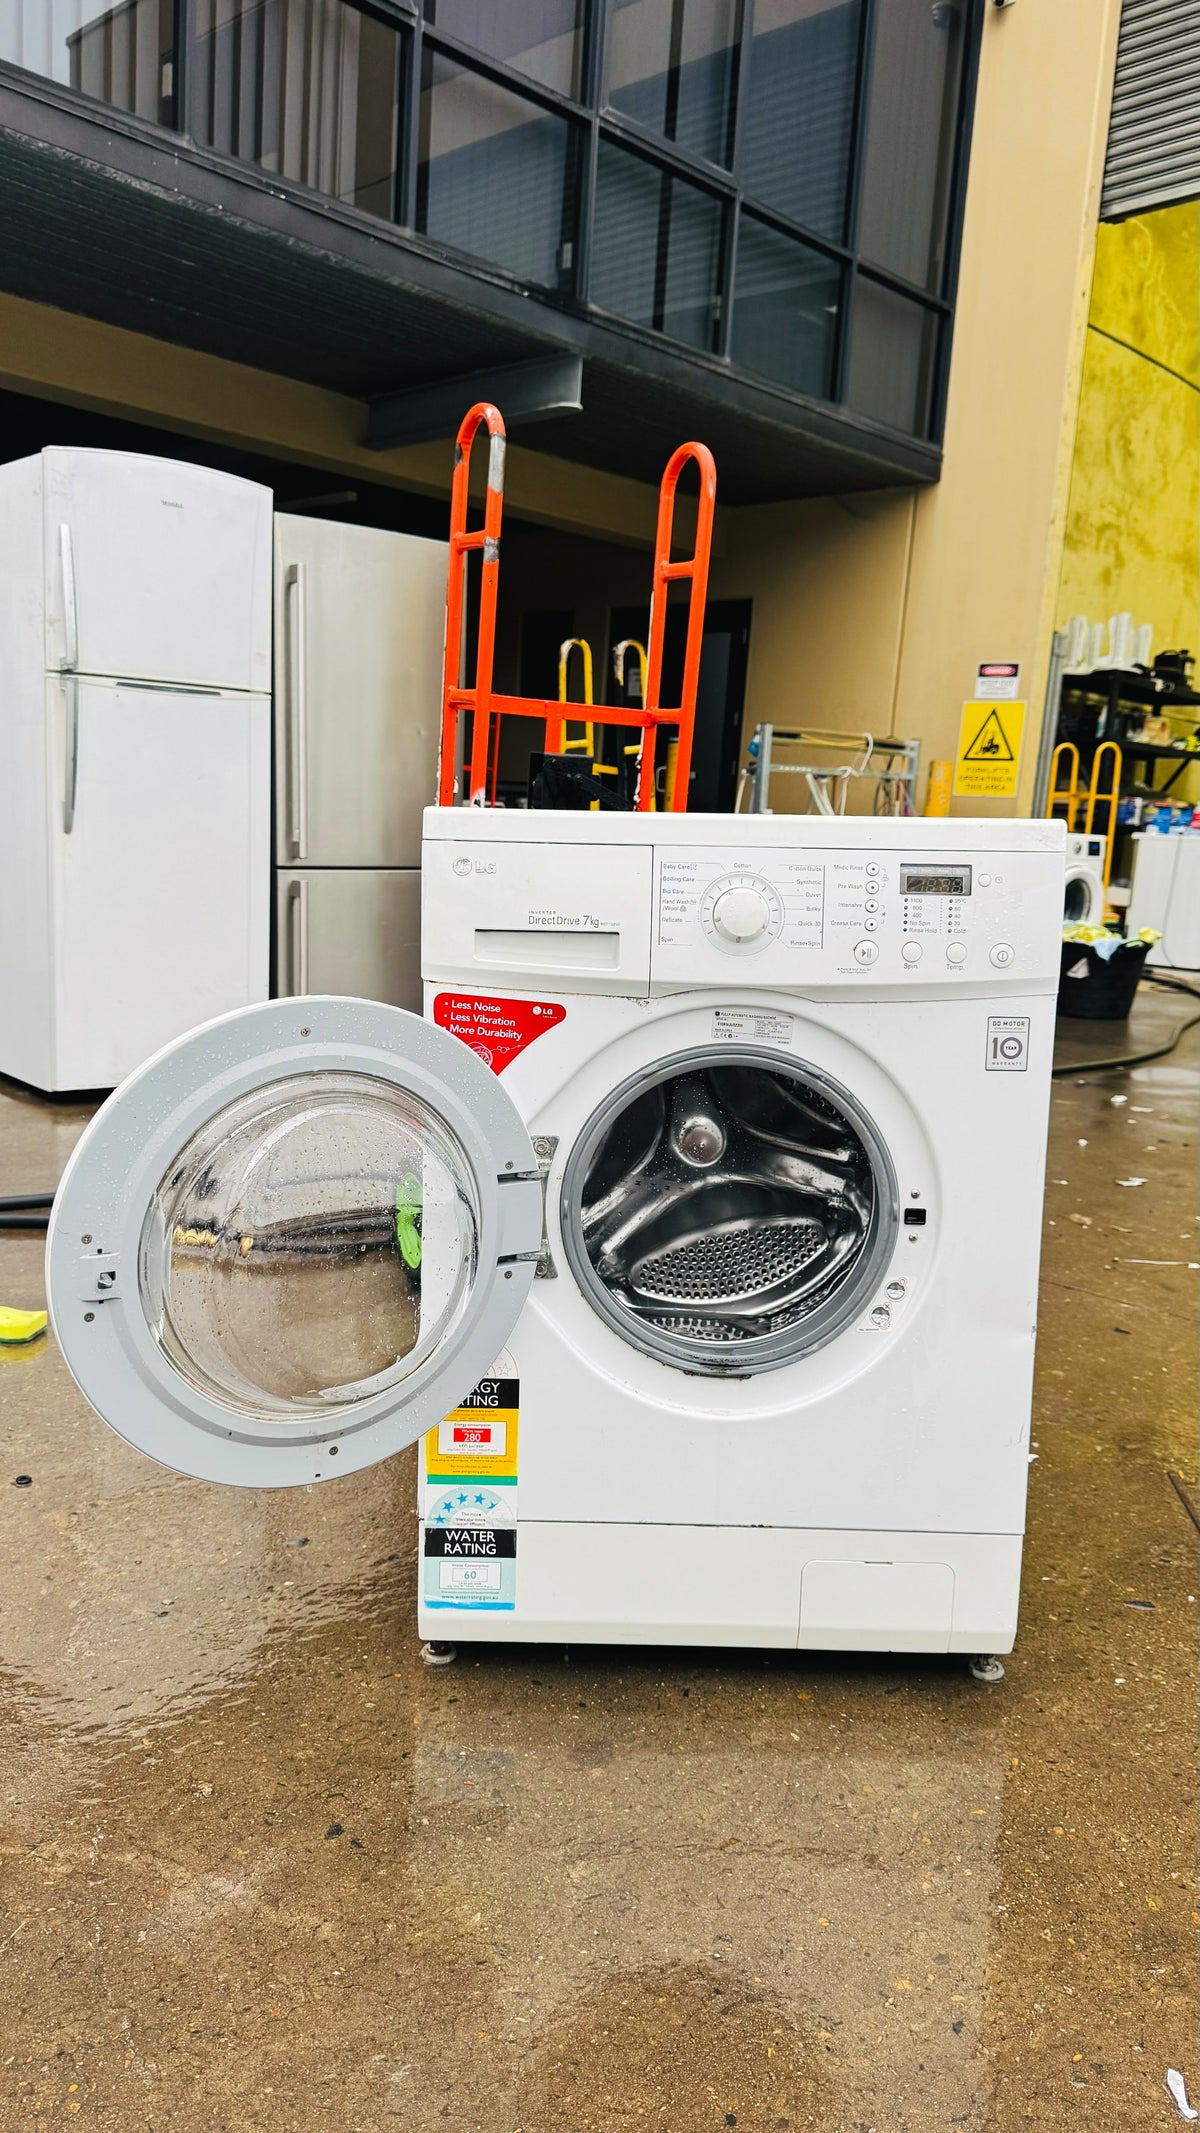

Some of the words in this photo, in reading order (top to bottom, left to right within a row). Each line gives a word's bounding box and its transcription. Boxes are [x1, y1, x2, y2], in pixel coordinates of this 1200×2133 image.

[475, 860, 496, 874] LG
[663, 863, 676, 871] Baby
[452, 1000, 471, 1010] Less
[474, 1002, 501, 1013] Noise
[450, 1012, 470, 1022] Less
[473, 1015, 516, 1027] Vibration
[449, 1024, 475, 1034] More
[477, 1027, 522, 1041] Durability
[992, 1037, 1022, 1059] 10
[464, 1434, 481, 1442] 280
[446, 1530, 495, 1542] WATER
[444, 1543, 496, 1554] RATING
[464, 1571, 477, 1580] 60
